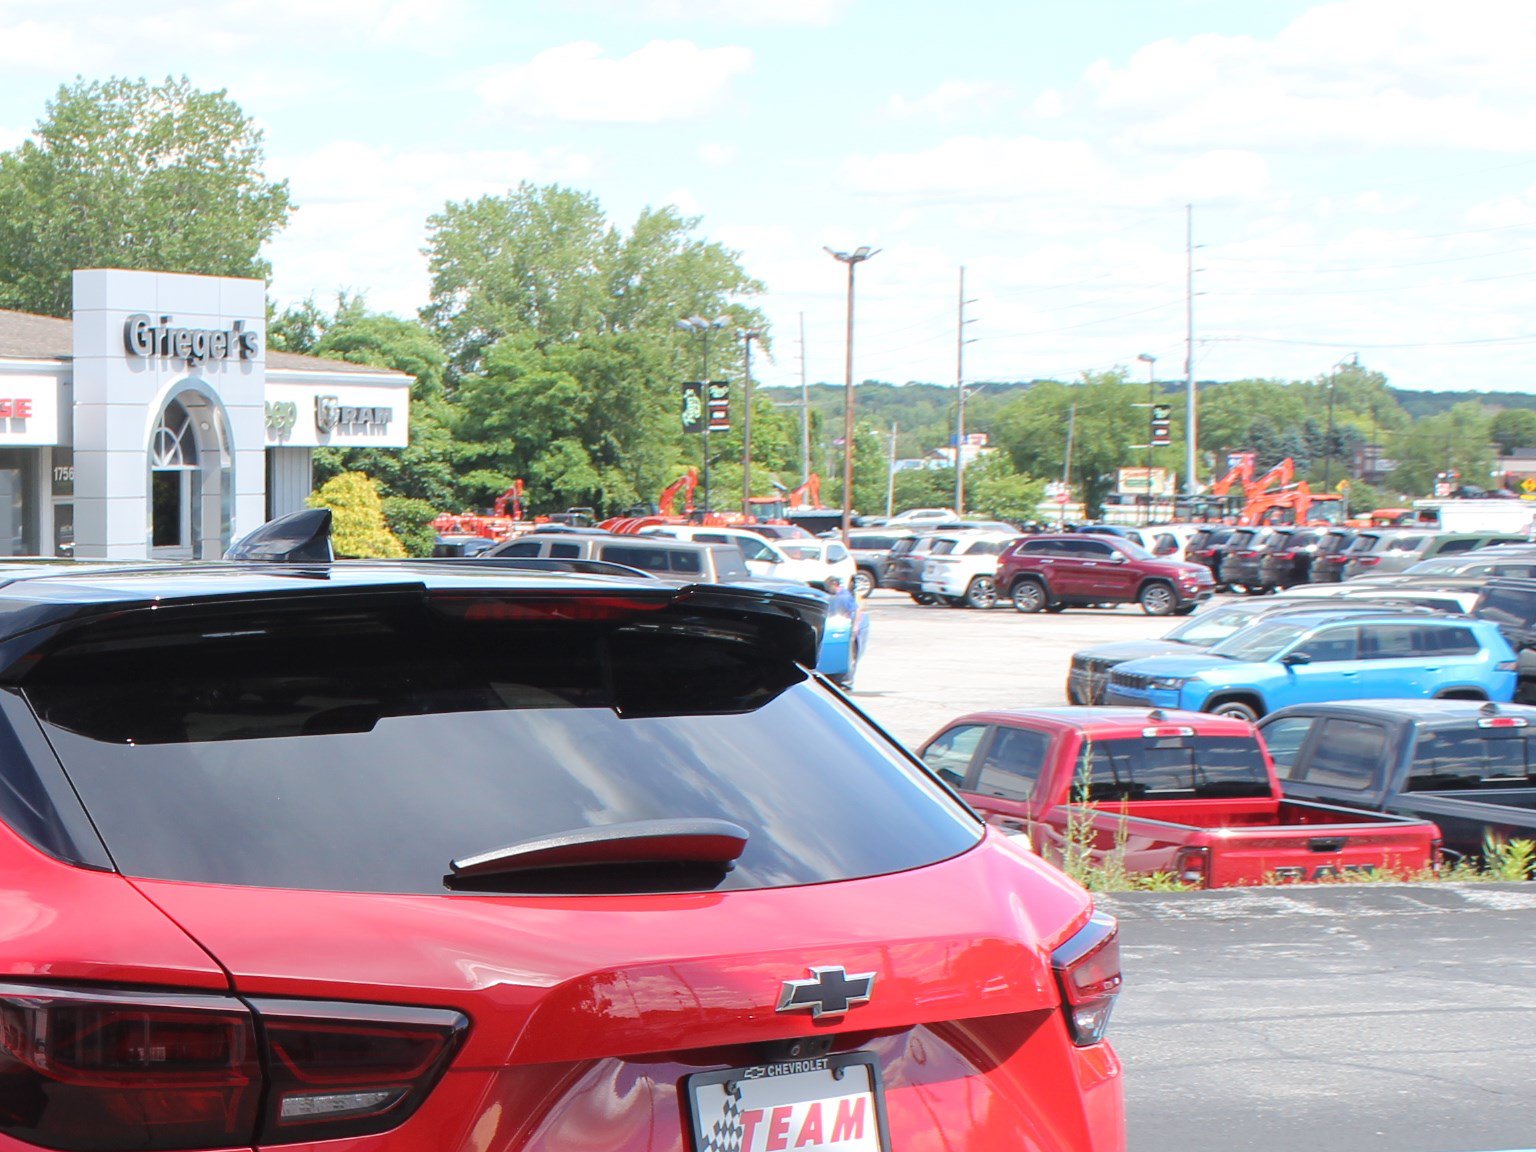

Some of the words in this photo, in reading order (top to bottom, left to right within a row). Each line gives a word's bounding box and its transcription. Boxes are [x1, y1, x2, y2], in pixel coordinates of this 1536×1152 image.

[125, 313, 259, 367] Grieger's
[338, 407, 393, 424] RAM
[767, 1058, 829, 1077] CHEVROLET
